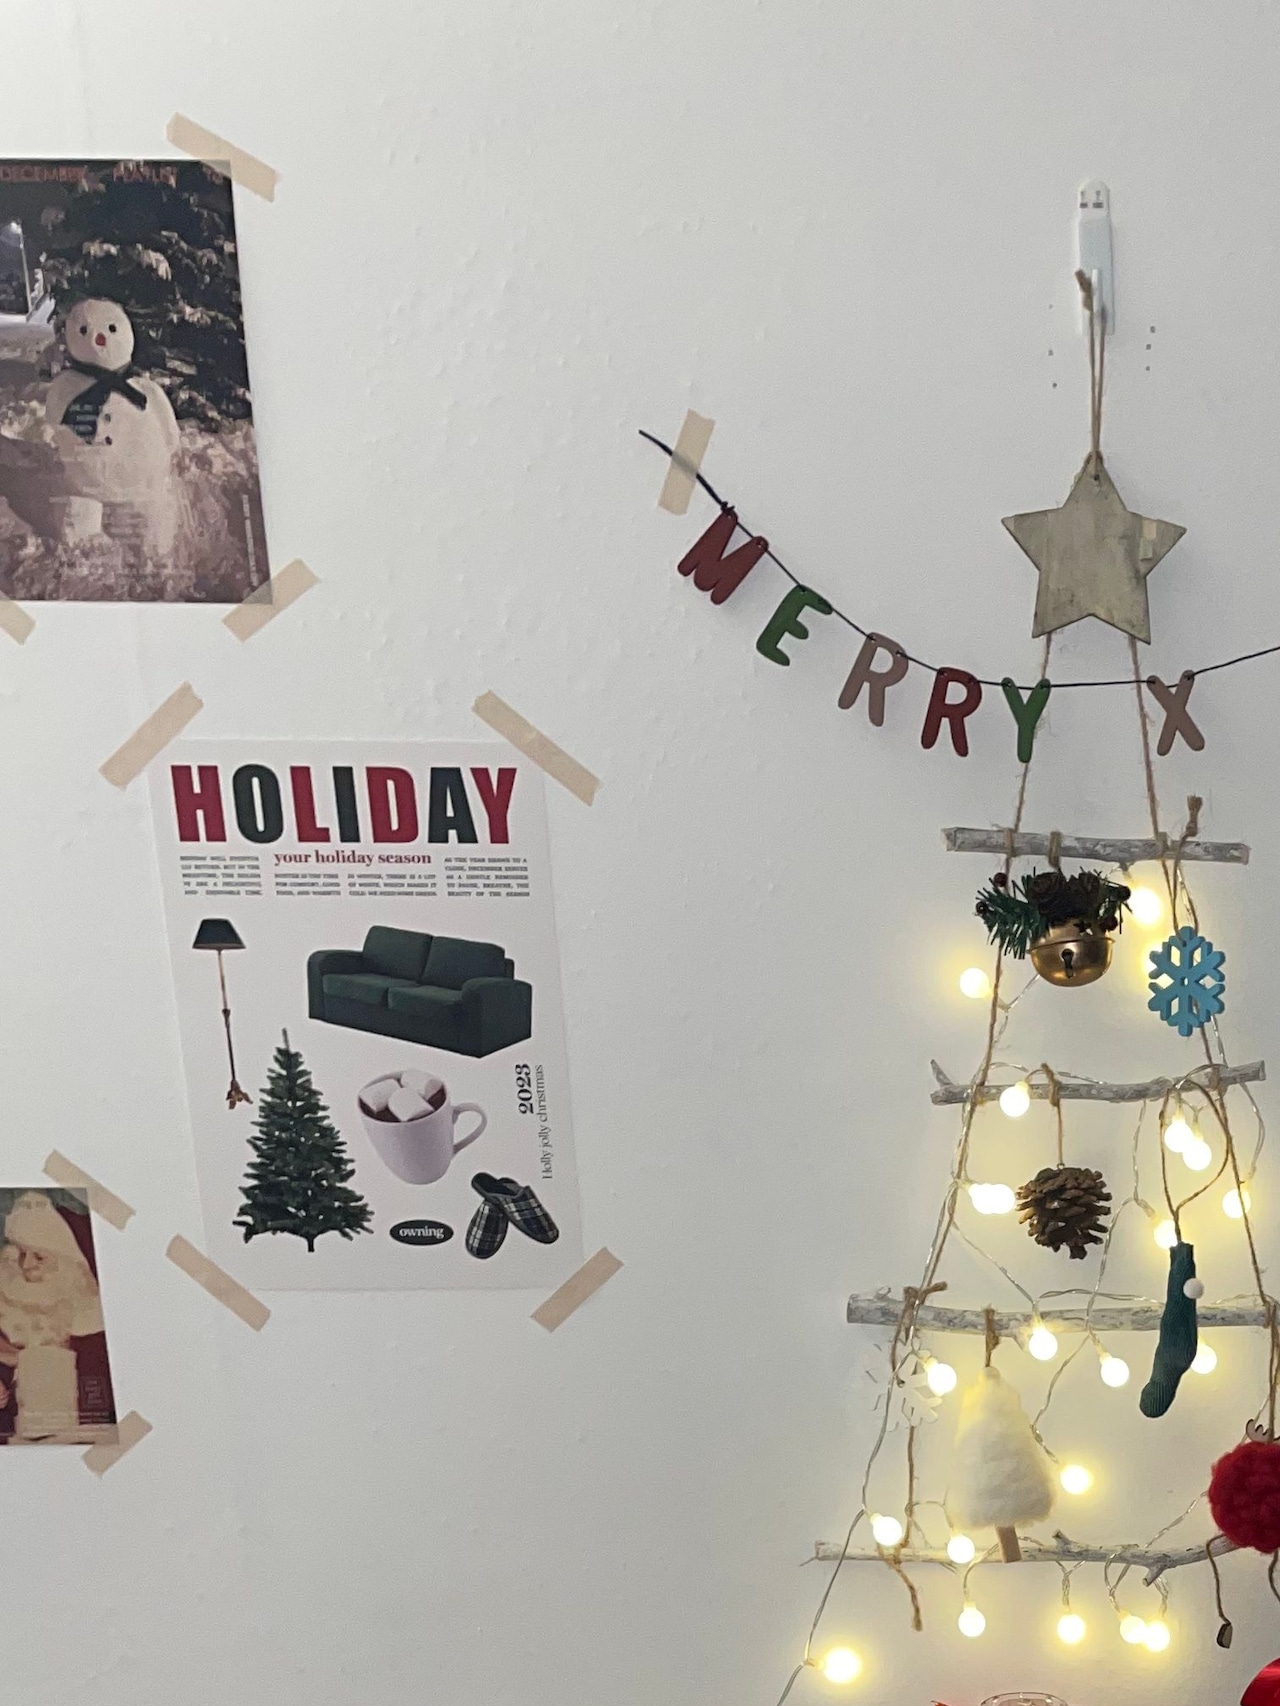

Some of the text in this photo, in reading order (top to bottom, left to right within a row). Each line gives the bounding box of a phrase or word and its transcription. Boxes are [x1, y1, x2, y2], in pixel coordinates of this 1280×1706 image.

[676, 509, 1052, 763] MERRY
[171, 763, 517, 844] HOLIDAY
[274, 849, 432, 867] your holiday season
[515, 1063, 534, 1115] 2023
[535, 1064, 554, 1180] Holly jolly christmas
[399, 1226, 444, 1239] owning
